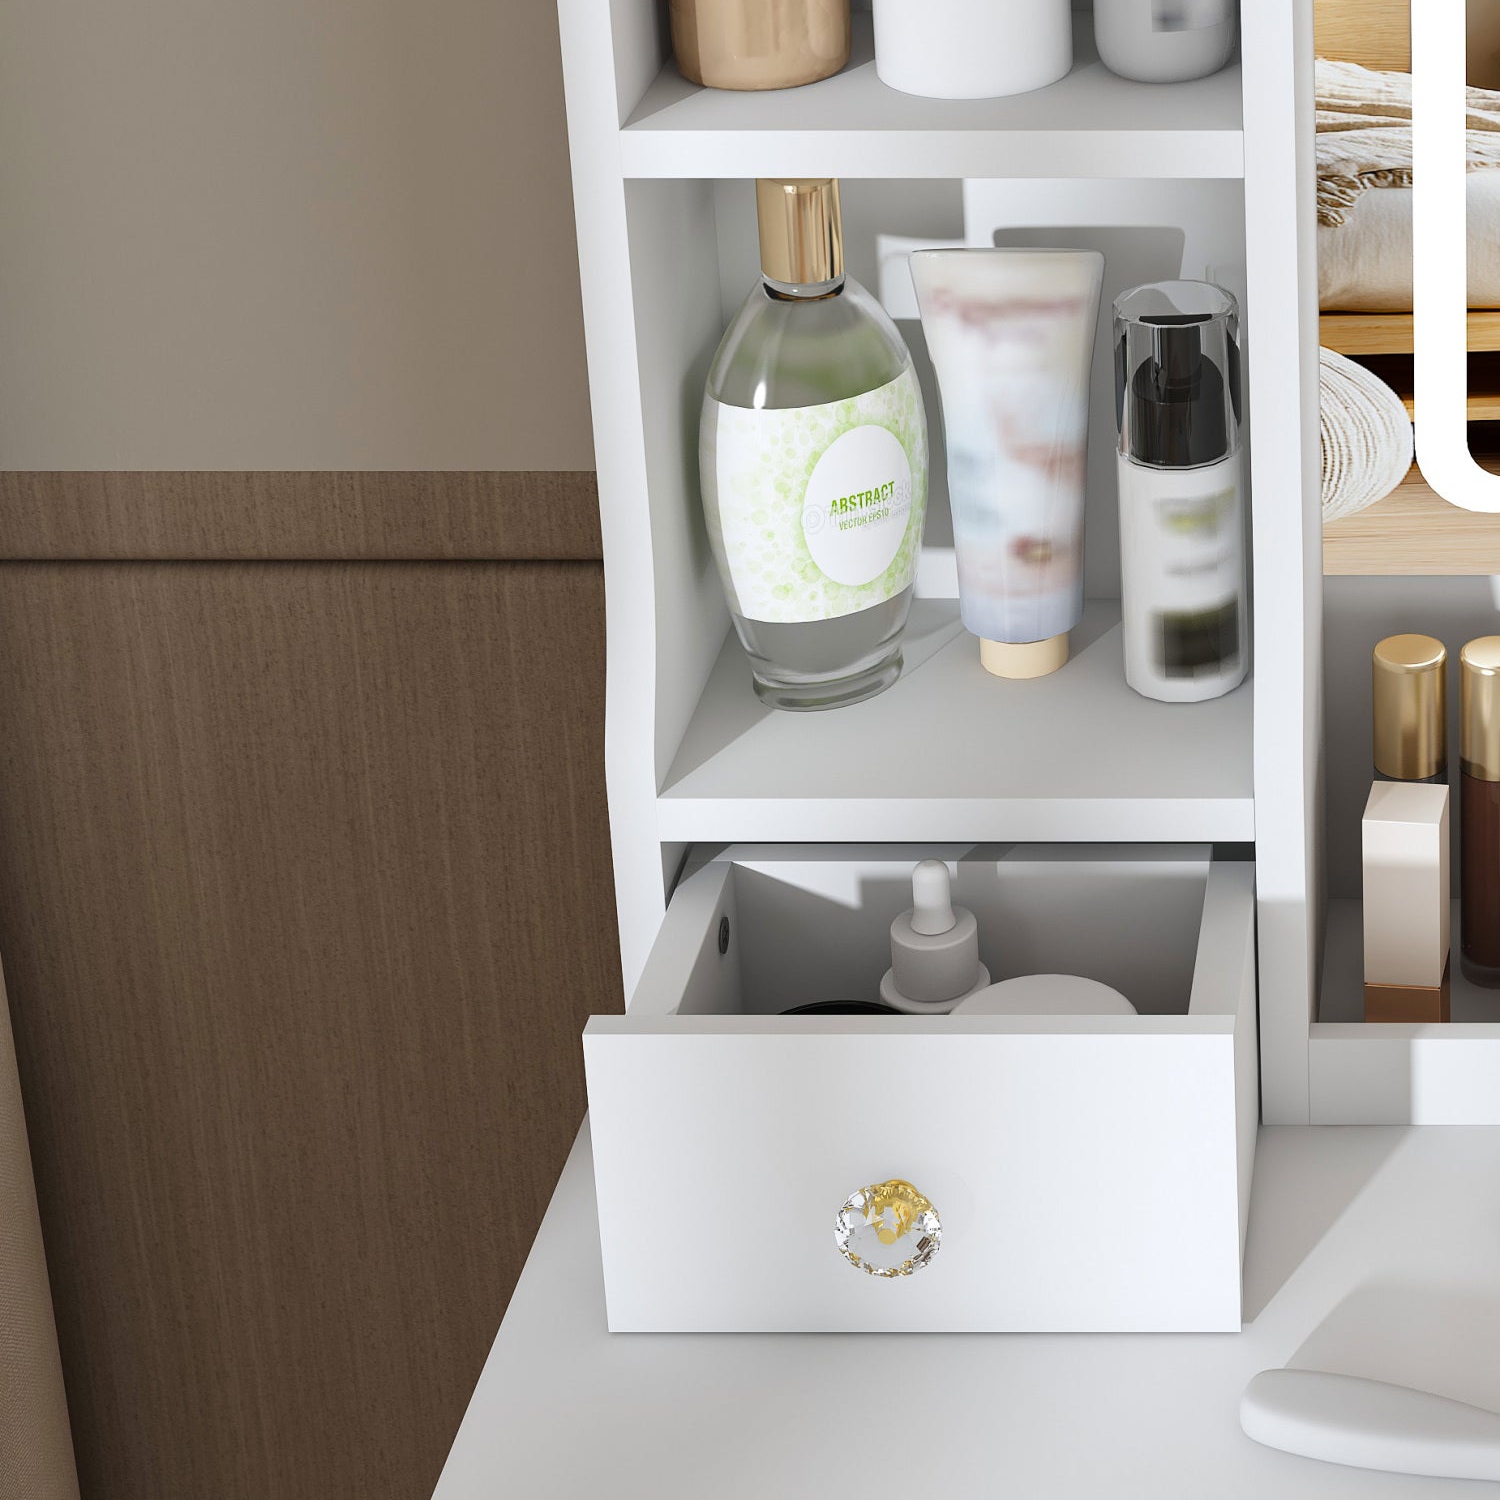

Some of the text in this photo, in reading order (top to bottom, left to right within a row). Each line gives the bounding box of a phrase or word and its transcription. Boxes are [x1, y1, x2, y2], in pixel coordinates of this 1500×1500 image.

[830, 481, 895, 516] ABSTRACT
[838, 507, 890, 531] VECTOR EPS10
